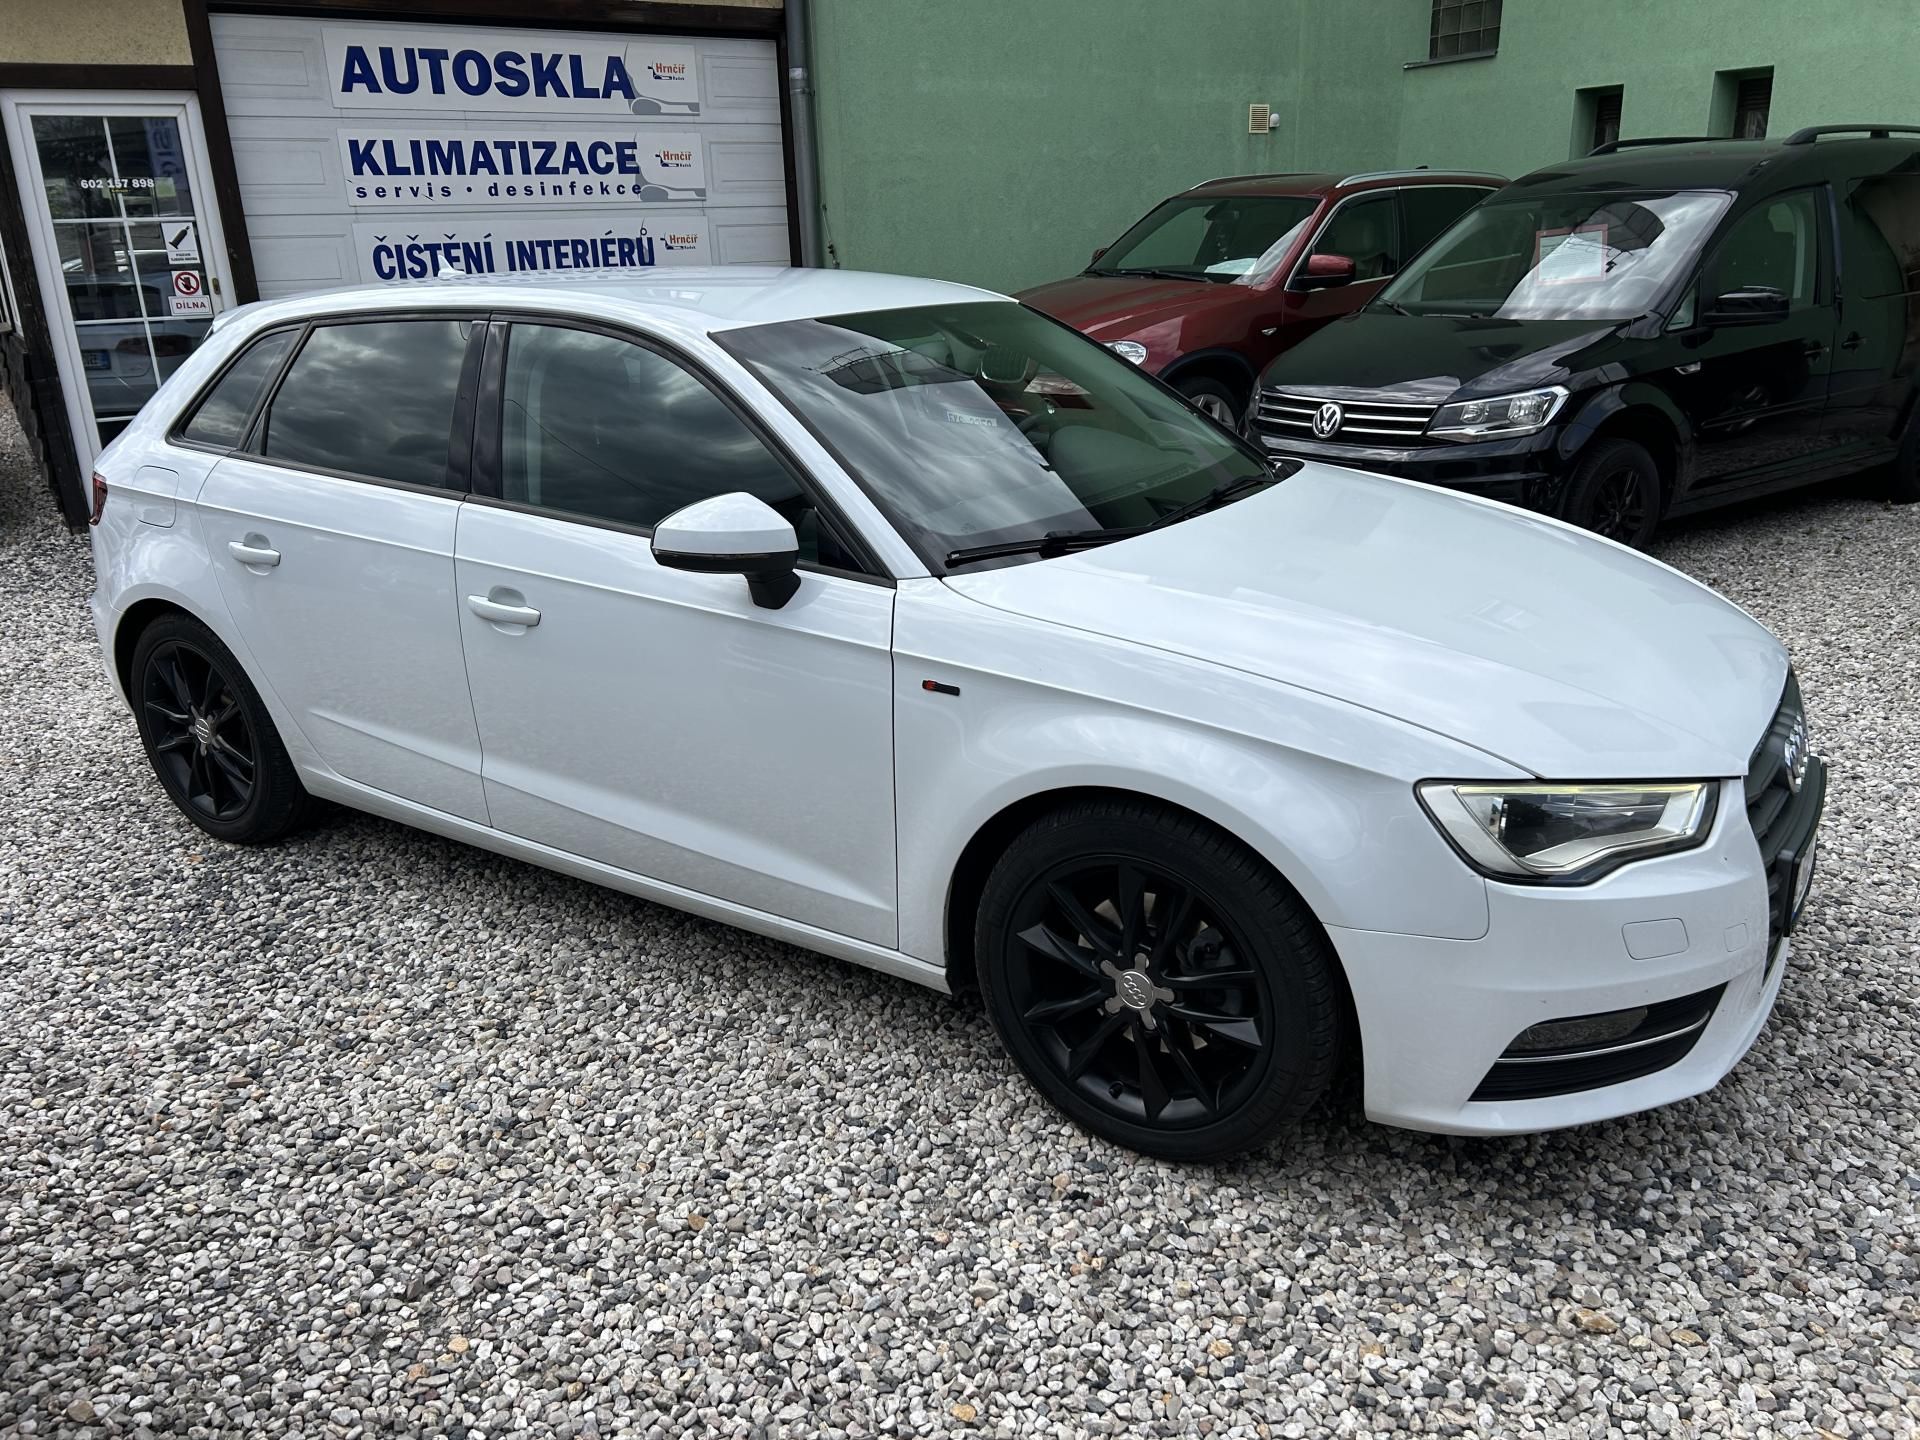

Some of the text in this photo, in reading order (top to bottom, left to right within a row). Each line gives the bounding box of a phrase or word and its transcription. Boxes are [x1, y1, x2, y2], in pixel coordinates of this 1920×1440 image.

[341, 45, 636, 100] AUTOSKLA
[347, 139, 640, 176] KLIMATIZACE
[80, 178, 155, 189] 602 157 898
[356, 181, 642, 199] servis desinfekce
[372, 227, 656, 280] ČIŠTĚNÍ INTERIÉRŮ
